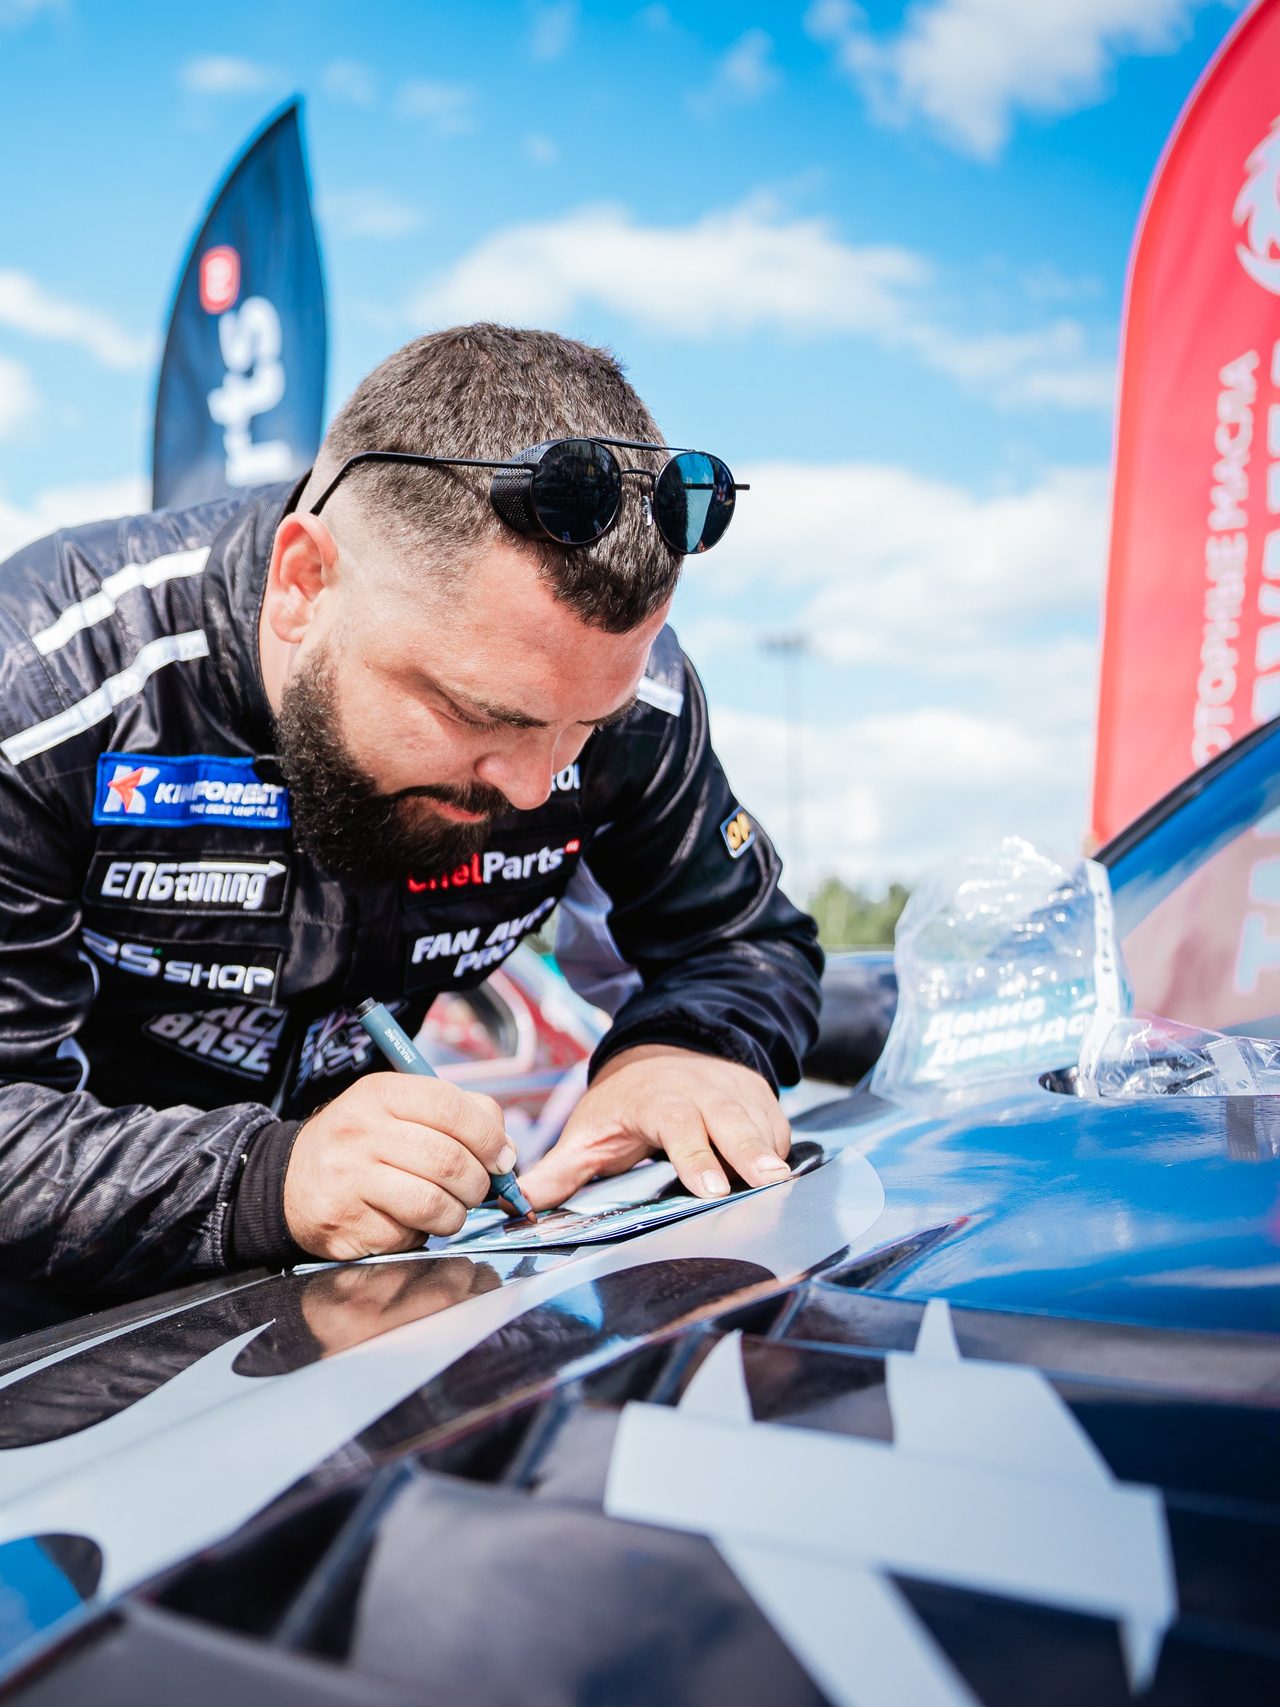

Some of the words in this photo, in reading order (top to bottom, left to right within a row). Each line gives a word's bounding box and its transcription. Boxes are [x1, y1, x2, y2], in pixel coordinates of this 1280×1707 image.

[1192, 533, 1249, 767] ОТОРНЫЕ
[411, 926, 480, 964] FAN
[163, 960, 275, 994] SHOP
[149, 1013, 277, 1074] BASE
[384, 1028, 413, 1064] MULTILINE
